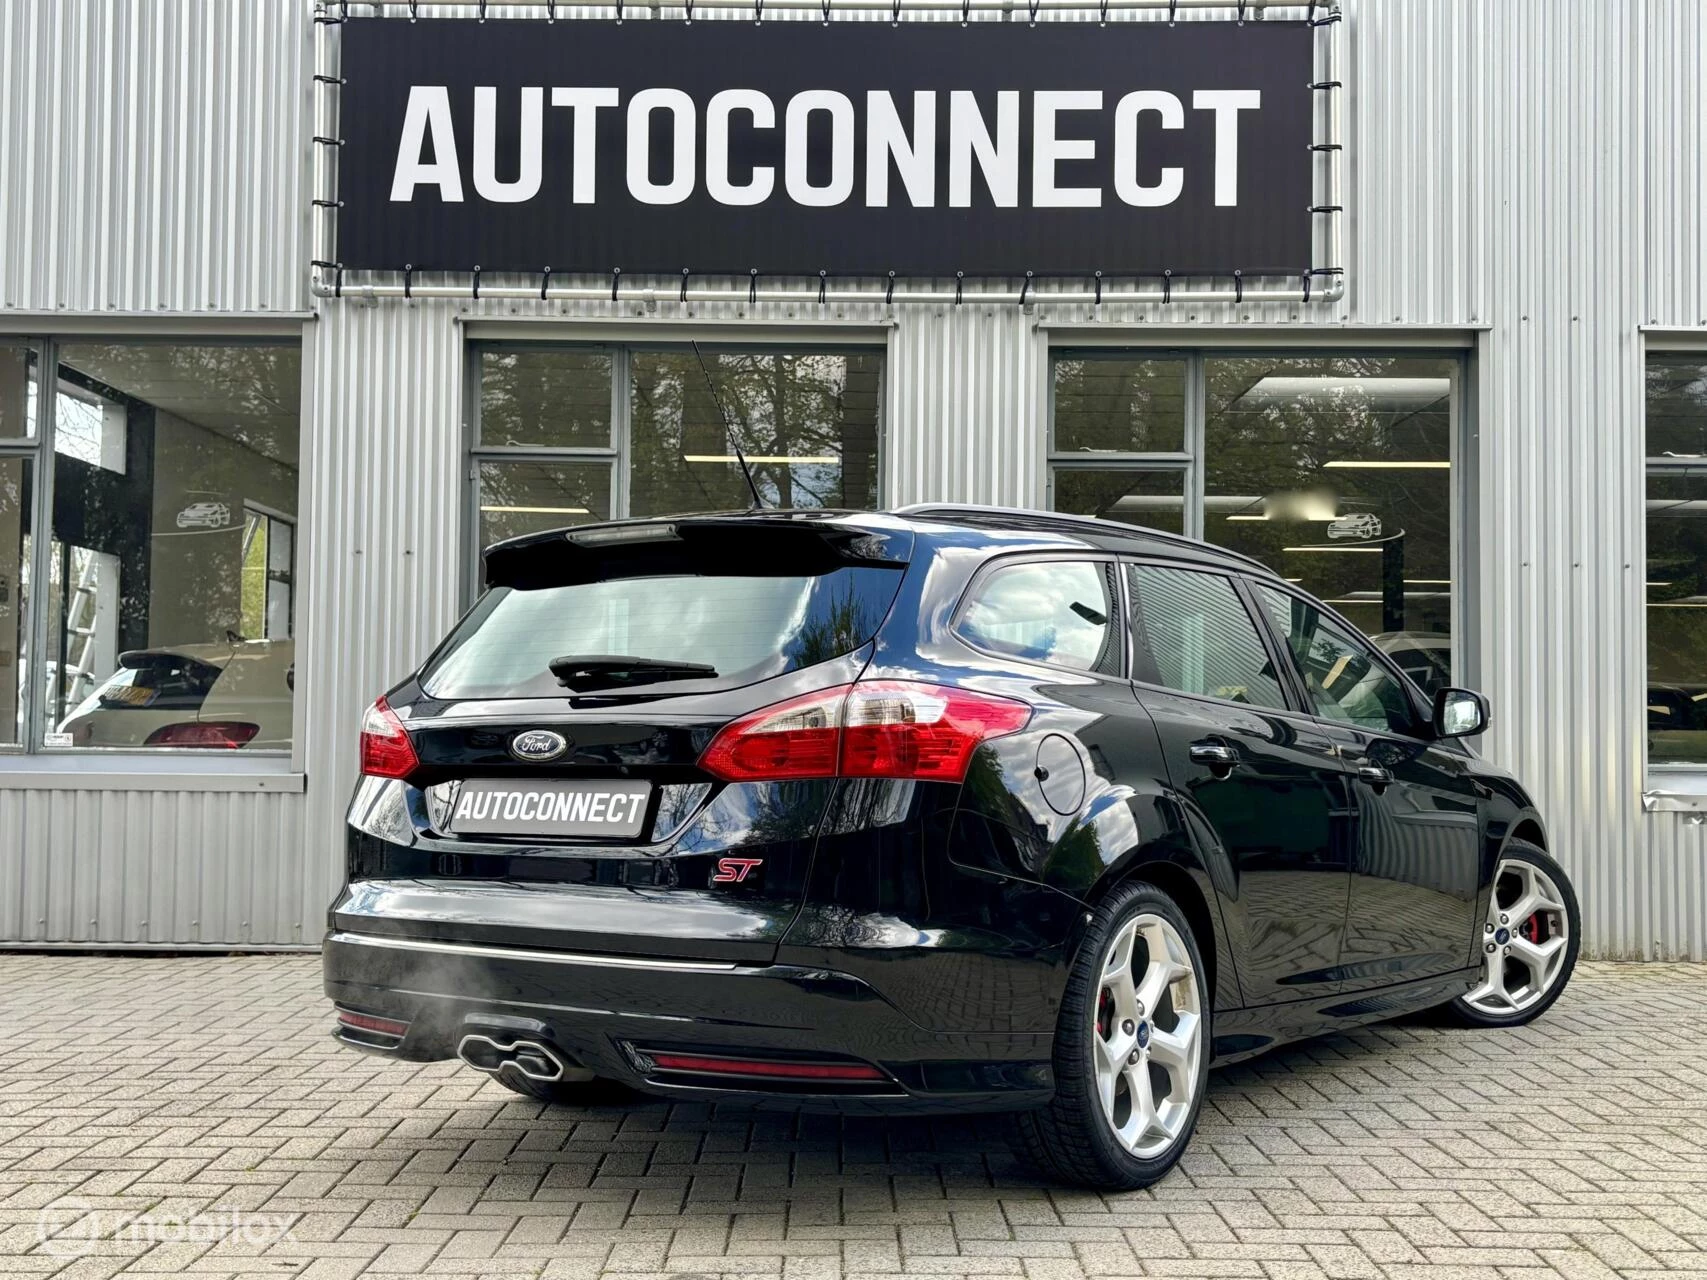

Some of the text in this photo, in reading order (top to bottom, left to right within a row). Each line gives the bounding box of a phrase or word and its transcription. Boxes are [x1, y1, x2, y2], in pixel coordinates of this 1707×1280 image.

[390, 86, 1261, 207] AUTOCONNECT
[455, 791, 646, 823] AUTOCONNECT
[713, 857, 762, 882] ST
